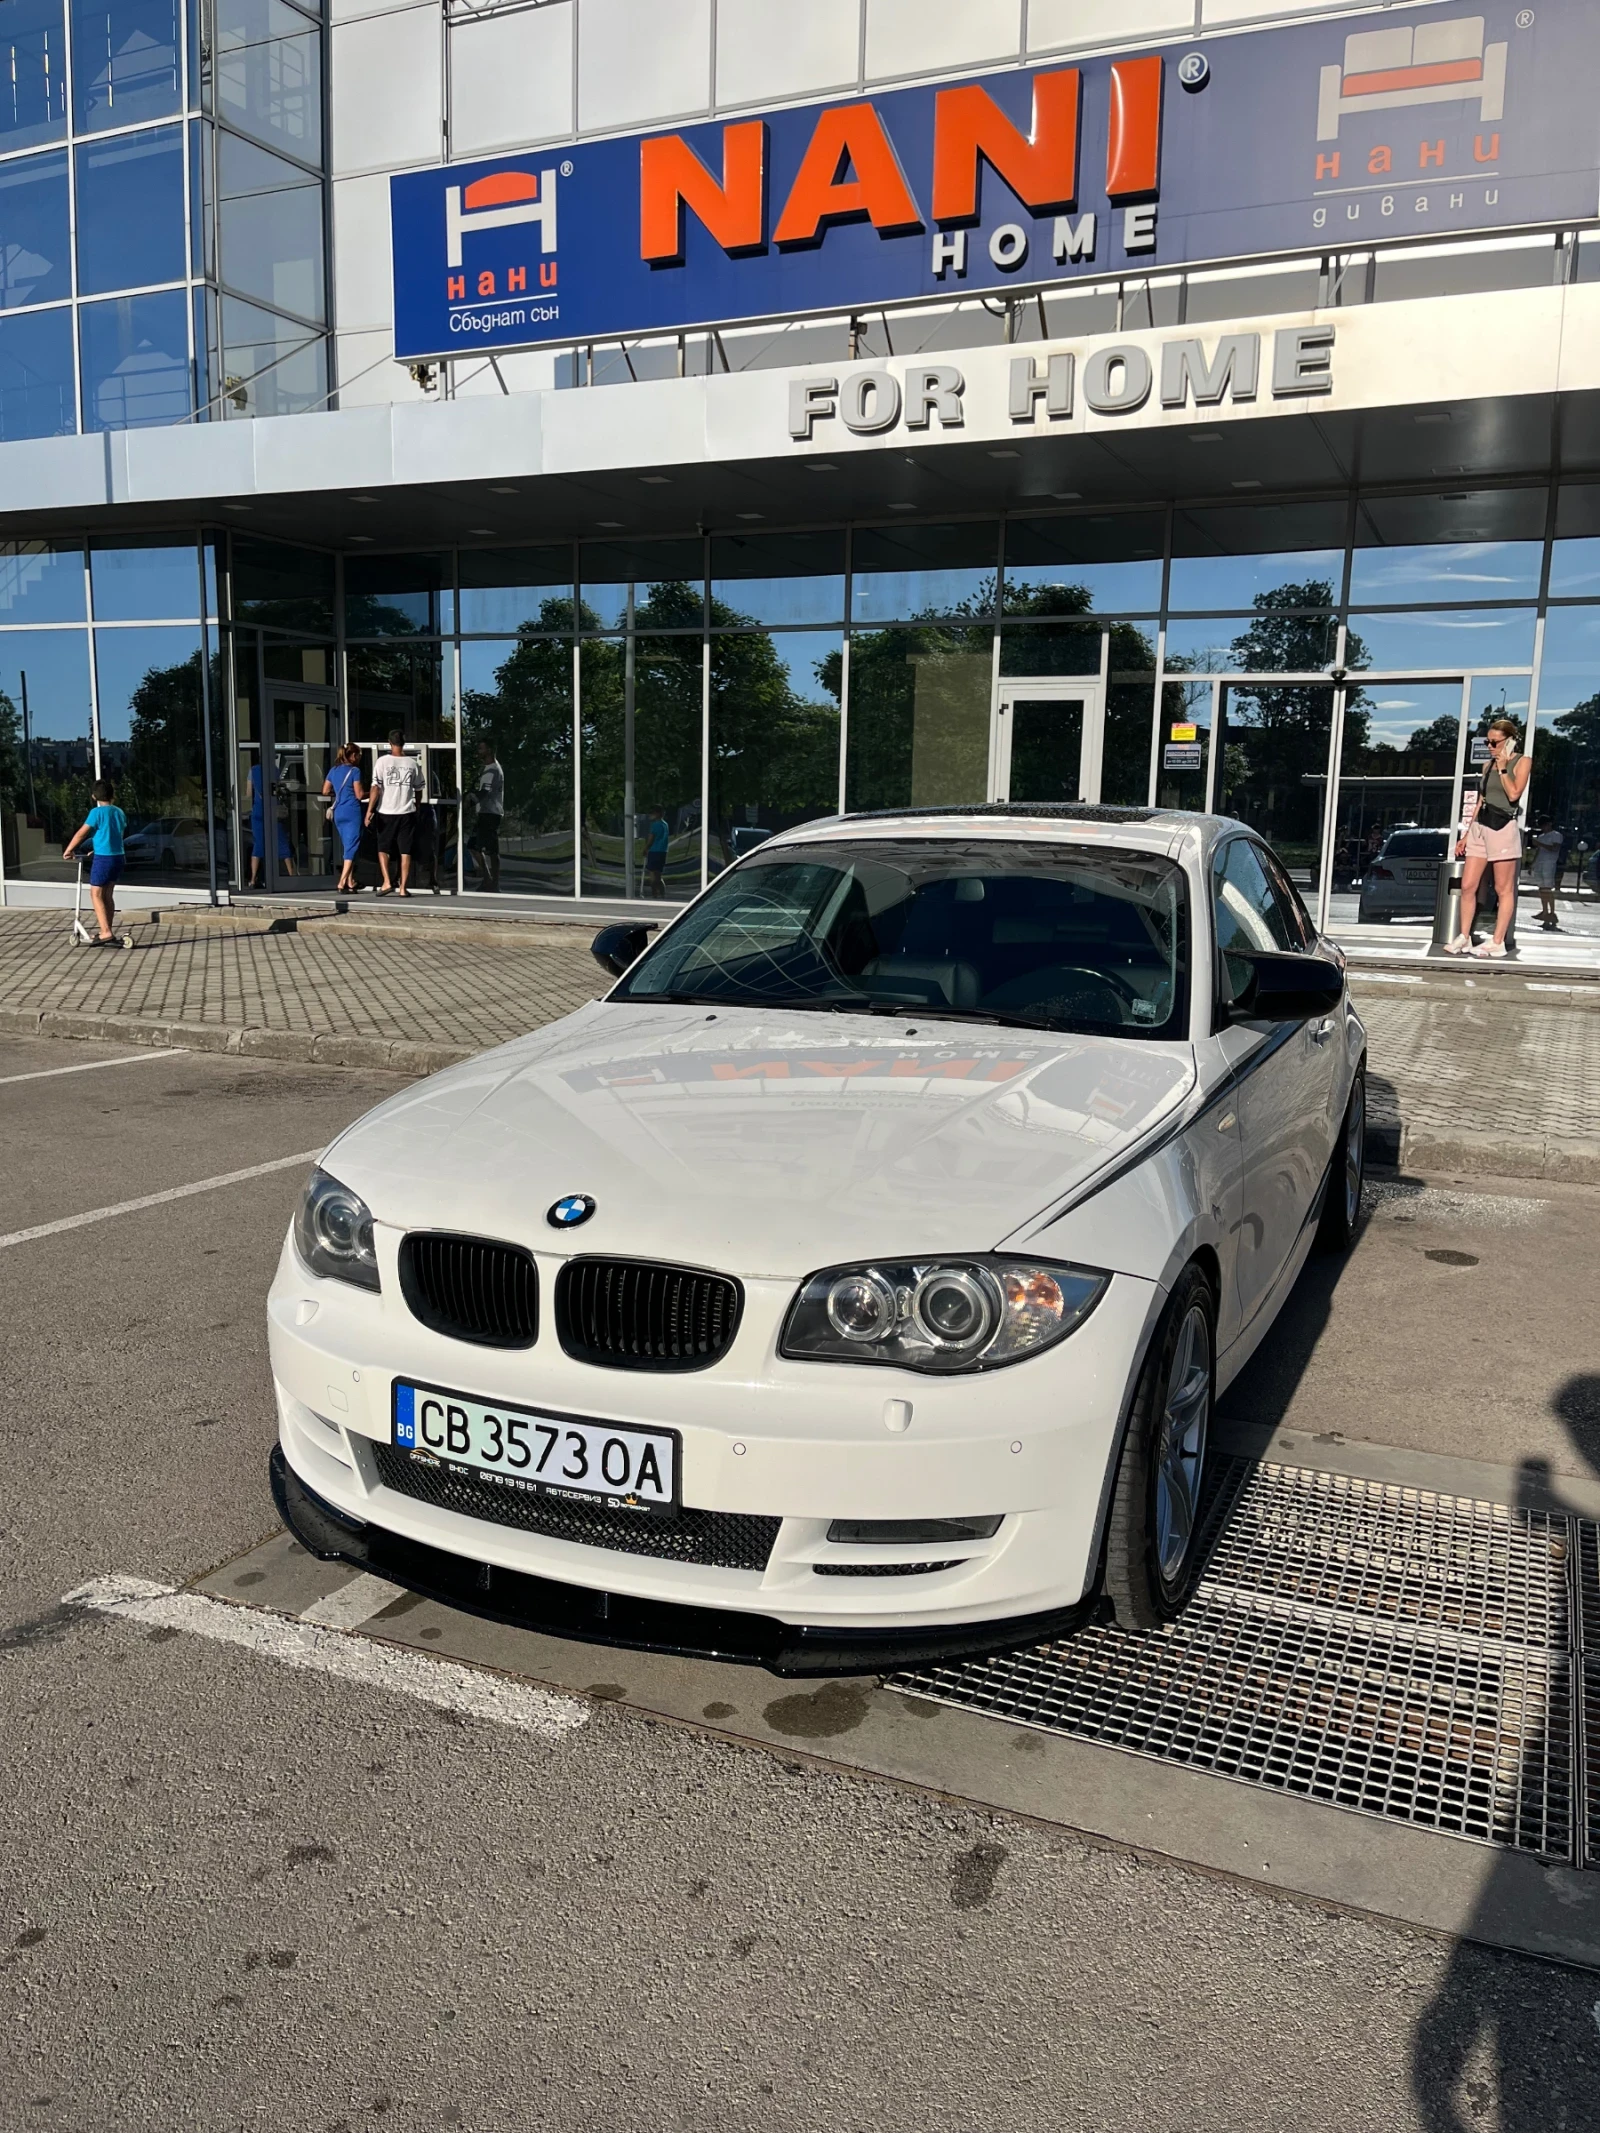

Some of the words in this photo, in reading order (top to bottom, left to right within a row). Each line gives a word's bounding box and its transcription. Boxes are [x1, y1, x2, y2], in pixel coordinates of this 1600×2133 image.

[640, 56, 1163, 262] NANI
[1312, 186, 1499, 228] дивани
[932, 204, 1157, 276] HOME
[449, 309, 526, 333] Сбъднат
[531, 304, 560, 325] сън
[788, 365, 965, 440] FOR
[1009, 324, 1336, 420] HOME
[397, 1422, 414, 1440] BG
[420, 1399, 470, 1454] CB
[480, 1414, 588, 1480] 3573
[601, 1437, 664, 1494] OA
[545, 1486, 602, 1504] АВТОСЕРВИЗ
